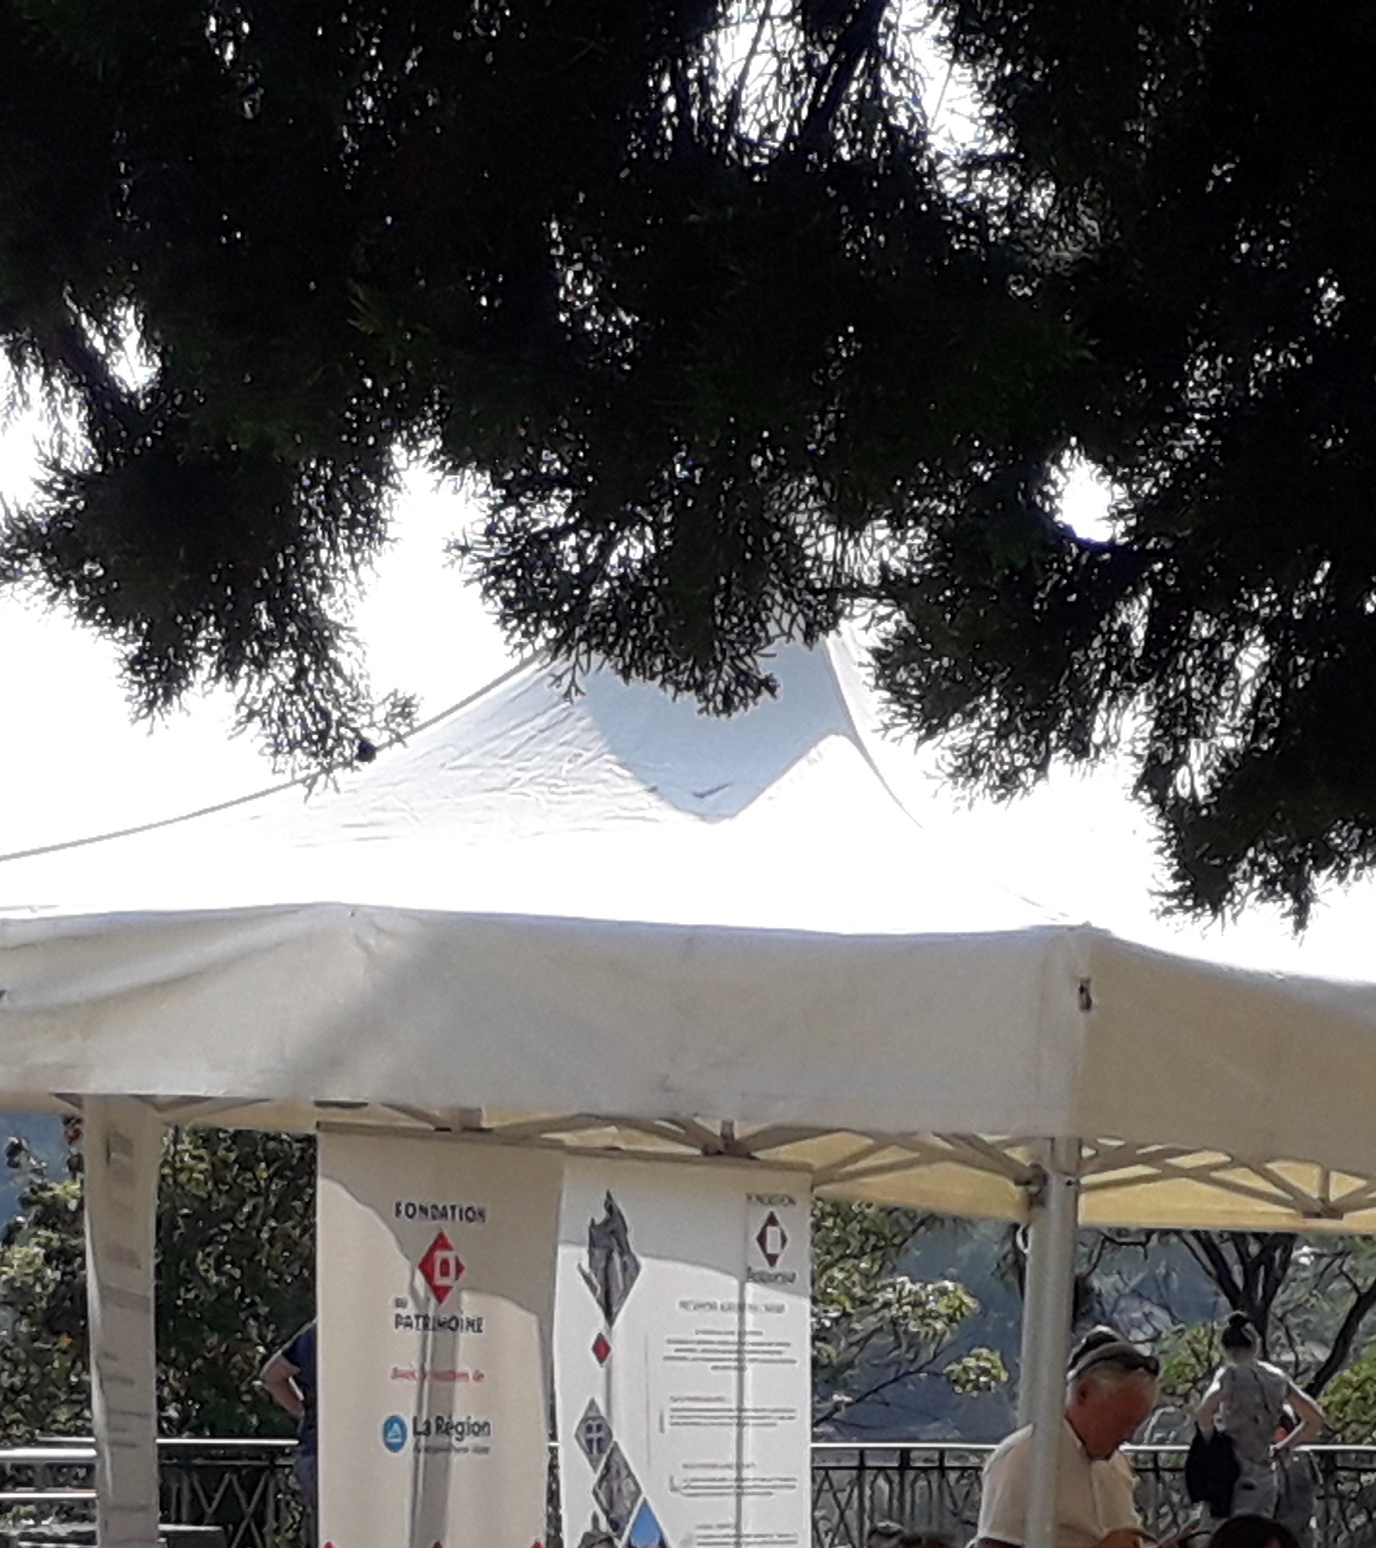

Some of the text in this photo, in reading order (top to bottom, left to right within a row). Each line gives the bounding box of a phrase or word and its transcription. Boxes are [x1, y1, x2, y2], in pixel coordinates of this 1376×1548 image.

[395, 1202, 486, 1223] FONDATION
[394, 1313, 484, 1333] PATRIMOINE
[413, 1413, 491, 1441] La Région
